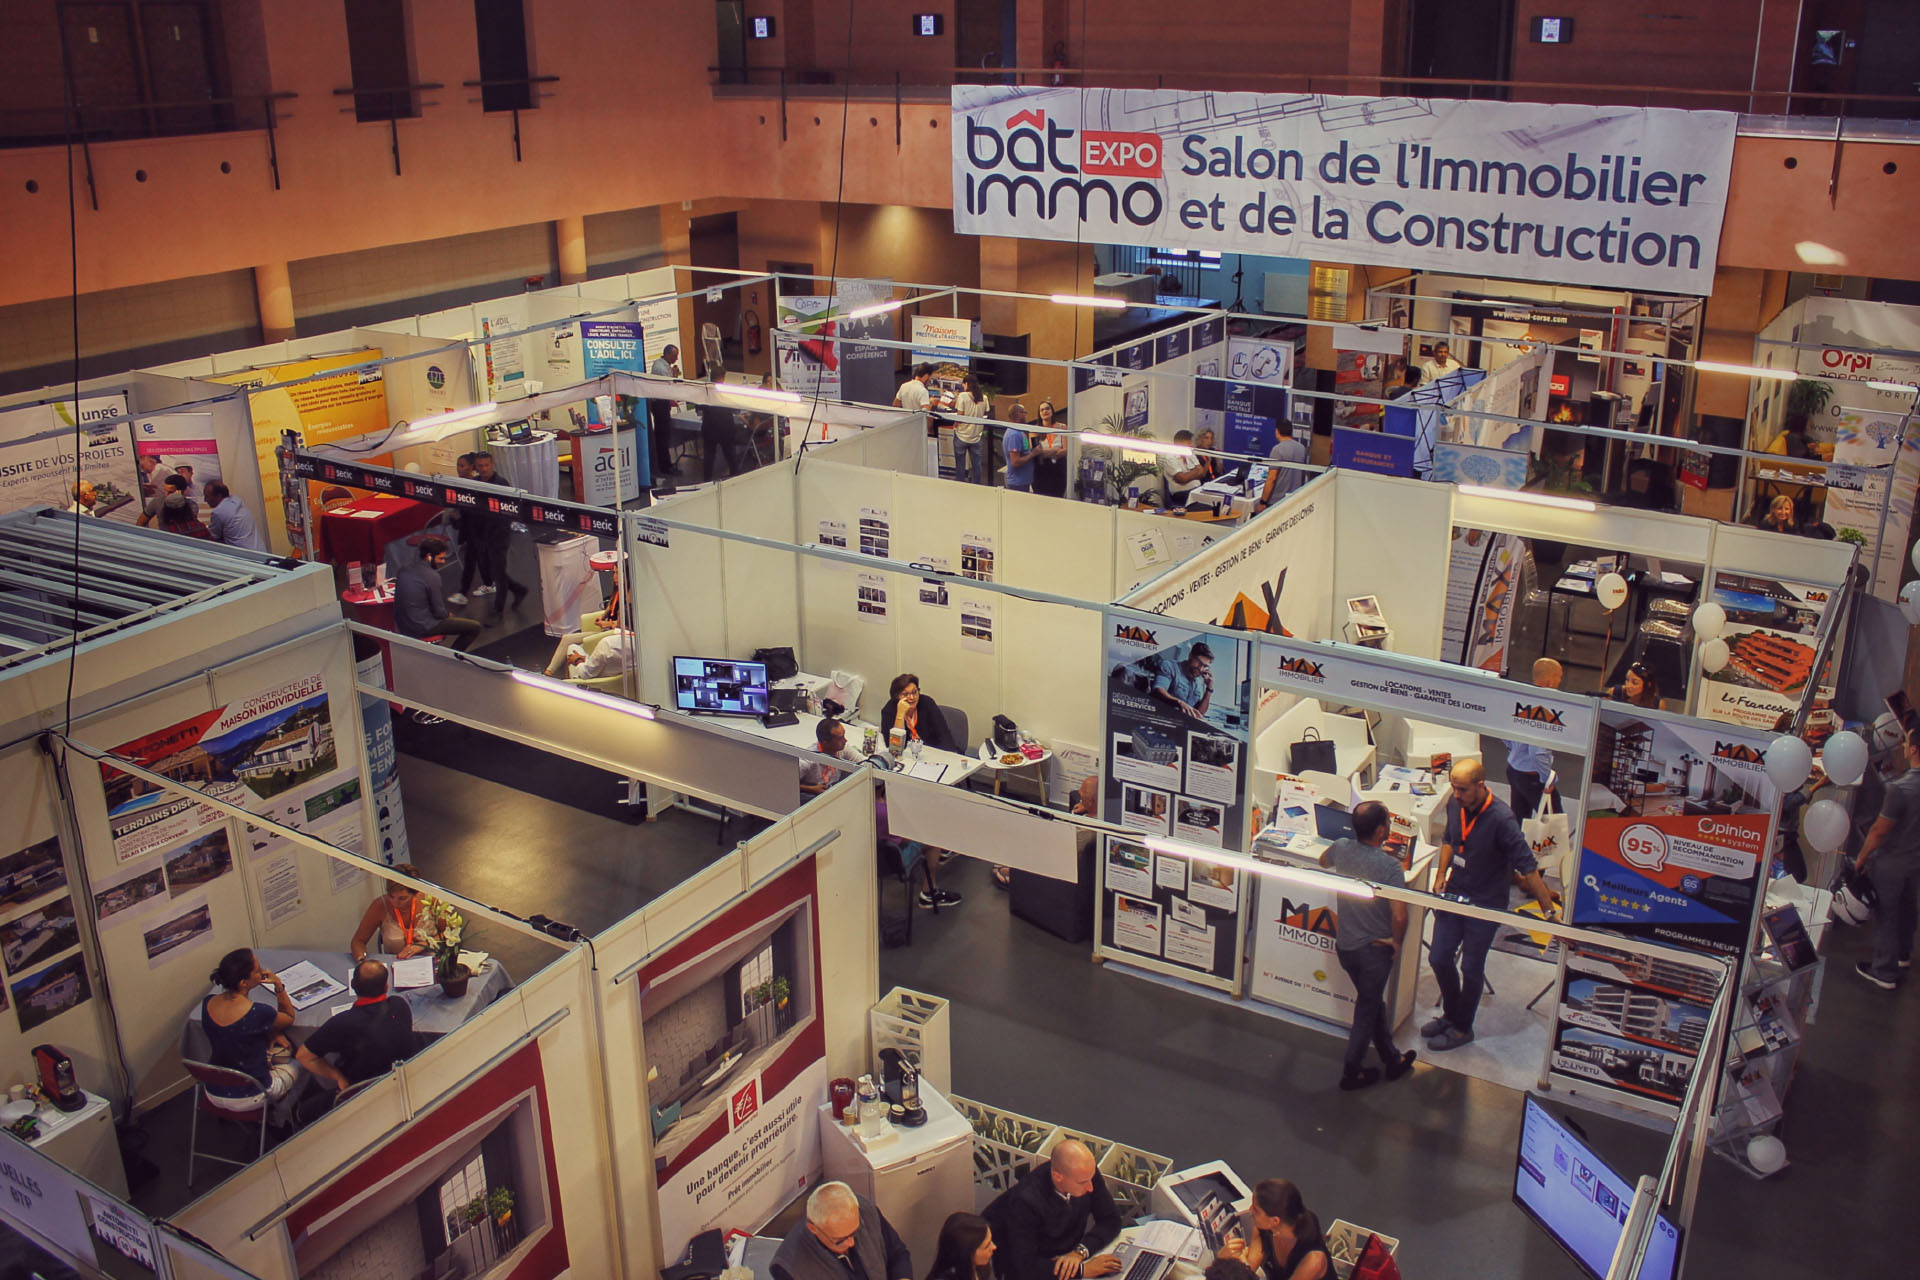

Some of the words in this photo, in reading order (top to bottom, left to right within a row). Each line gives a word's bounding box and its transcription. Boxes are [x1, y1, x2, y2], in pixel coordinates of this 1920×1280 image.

[1084, 140, 1157, 168] EXPO
[1181, 134, 1304, 181] Salon
[1318, 139, 1381, 187] de
[1396, 143, 1707, 208] l'Immobilier
[1179, 192, 1227, 232] et
[1238, 191, 1298, 236] de
[1313, 194, 1349, 241] la
[1366, 199, 1701, 271] Construction
[915, 331, 938, 339] PRESTIGE
[923, 323, 957, 336] Maisons
[587, 340, 637, 350] CONSULTEZ
[590, 350, 620, 360] L'ADIL,
[621, 350, 635, 360] ICI.
[846, 350, 888, 360] CONFÉRENCE
[1822, 349, 1873, 373] Orpi
[0, 461, 33, 478] SSITE
[35, 459, 49, 470] DE
[51, 453, 75, 466] VOS
[79, 446, 125, 461] PROJETS
[297, 461, 315, 473] secic
[336, 468, 353, 480] secic
[2, 475, 30, 488] Experts
[30, 467, 71, 481] repoussent
[84, 461, 110, 472] limites
[374, 476, 392, 488] secic
[415, 484, 433, 497] secic
[457, 493, 476, 505] secic
[500, 501, 519, 514] secic
[544, 509, 565, 522] secic
[592, 518, 613, 532] secic
[1149, 586, 1185, 615] LOCATIONS
[1189, 574, 1210, 596] VENTES
[1214, 555, 1239, 578] GESTION
[1240, 549, 1247, 560] DE
[1806, 591, 1829, 603] MA
[1115, 623, 1159, 646] MAX
[1116, 638, 1158, 651] IMMOBILIER
[1278, 655, 1326, 679] MAX
[1279, 670, 1325, 685] IMMOBILIER
[242, 678, 310, 710] CONSTRUCTEUR
[310, 673, 322, 684] DE
[1350, 679, 1379, 691] GESTION
[1380, 685, 1389, 693] DE
[1390, 687, 1408, 697] BIENS
[1414, 692, 1446, 705] GARANTIE
[1448, 699, 1461, 708] DES
[1462, 701, 1486, 713] LOYERS
[1385, 680, 1422, 693] LOCATIONS
[1428, 688, 1452, 699] VENTES
[220, 707, 258, 731] MAISON
[259, 681, 324, 714] INDIVIDUELLE
[1111, 698, 1126, 706] NOS
[1126, 699, 1157, 713] SERVICES
[1512, 702, 1565, 728] MAX
[1722, 692, 1735, 704] Le
[1737, 696, 1797, 716] Francesca
[1513, 717, 1564, 734] IMMOBILIER
[1712, 756, 1767, 773] IMMOBILIER
[1713, 740, 1768, 766] MAX
[115, 809, 171, 836] TERRAINS
[1697, 817, 1762, 842] Opinion
[148, 840, 161, 849] PRIX
[1672, 845, 1745, 867] RECOMMANDATION
[1673, 839, 1702, 851] NIVEAU
[1702, 844, 1715, 853] DE
[1727, 838, 1760, 851] system
[1280, 896, 1337, 939] MA
[1279, 924, 1334, 951] IMMOBI
[1654, 927, 1713, 947] PROGRAMMES
[1713, 940, 1741, 954] NEUFS
[686, 1175, 706, 1196] Une
[706, 1149, 742, 1181] banque,
[742, 1129, 762, 1152] c'est
[763, 1109, 786, 1134] aussi
[786, 1095, 803, 1116] utile
[695, 1180, 717, 1205] pour
[718, 1152, 751, 1185] devenir
[750, 1113, 799, 1160] propriétaire.
[0, 1162, 43, 1198] UELLES
[727, 1183, 742, 1200] Prêt
[741, 1157, 773, 1189] immobilier
[10, 1185, 33, 1210] BTP
[97, 1213, 148, 1249] CONSTRUCTION
[103, 1210, 140, 1238] ANTONETTI
